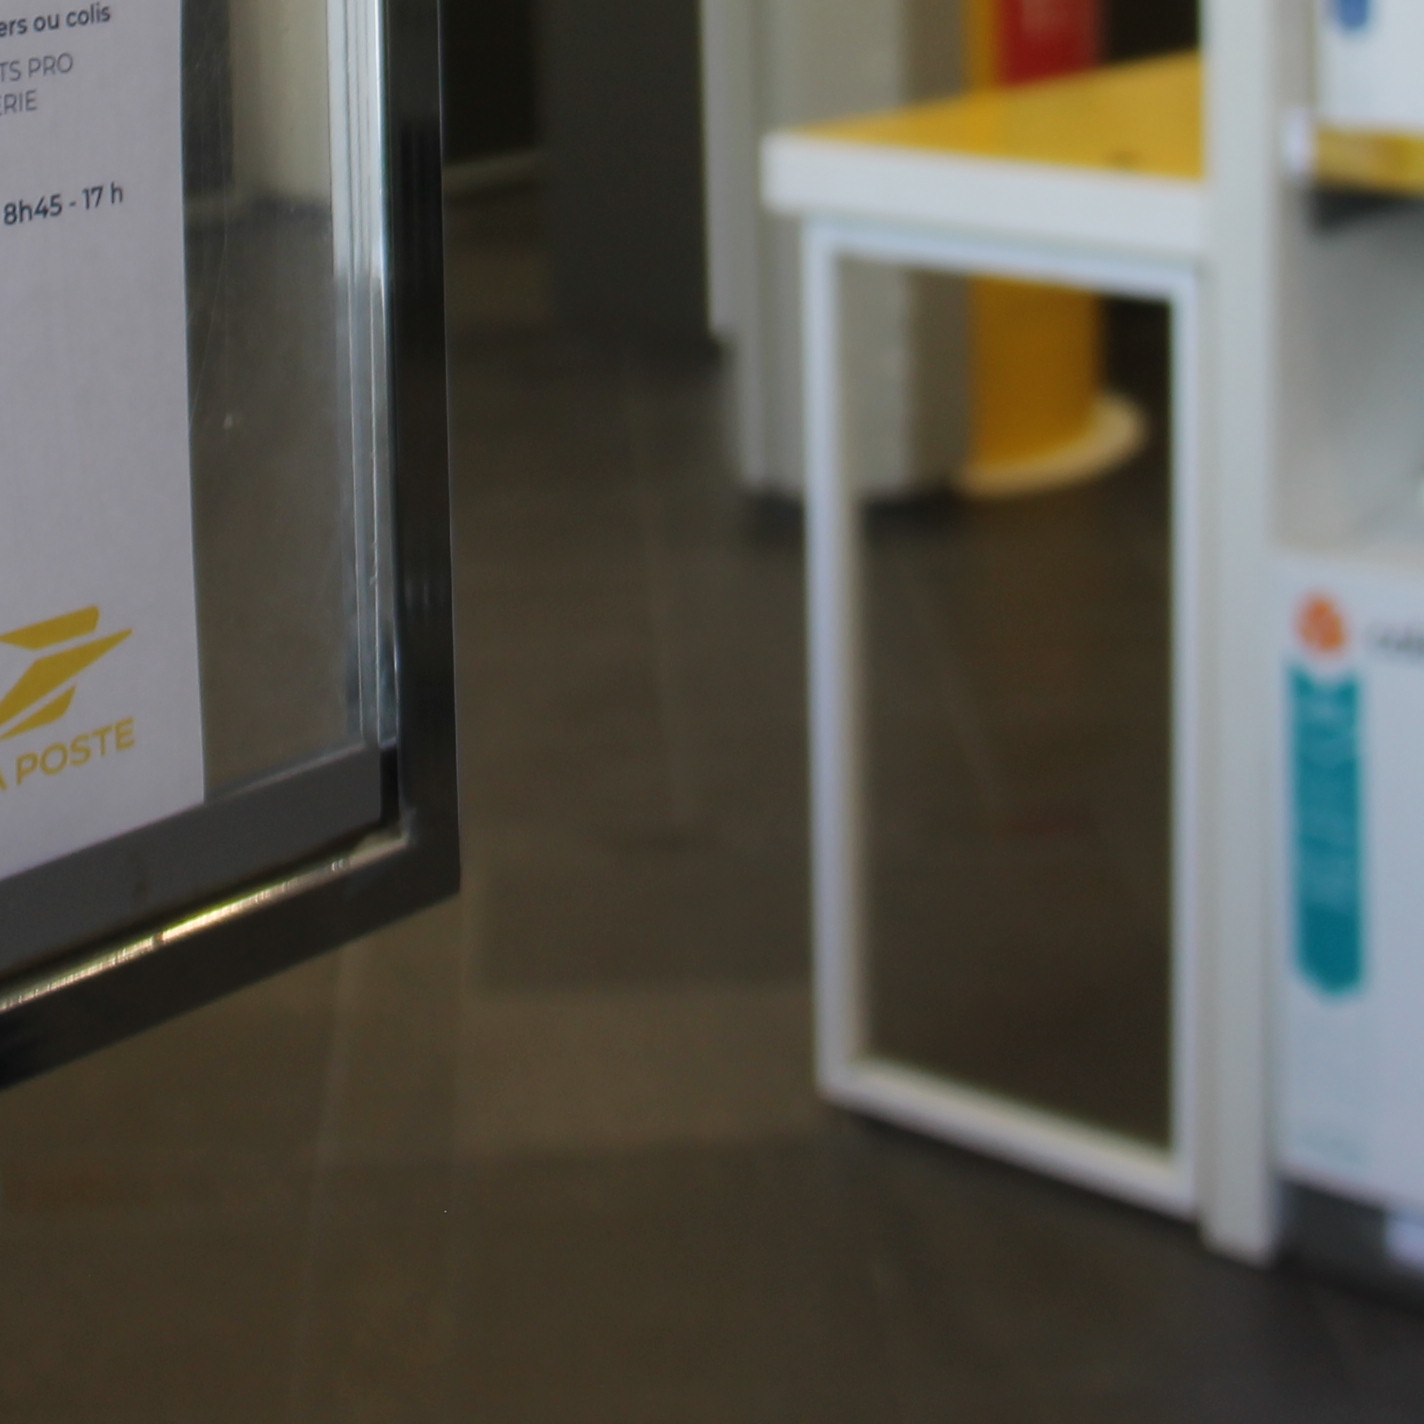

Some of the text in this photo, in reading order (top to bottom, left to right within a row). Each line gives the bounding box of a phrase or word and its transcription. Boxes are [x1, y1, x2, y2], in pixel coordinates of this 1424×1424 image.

[32, 13, 61, 33] ou
[65, 2, 112, 28] colis
[27, 51, 75, 78] PRO
[3, 193, 63, 226] 8h45
[16, 718, 134, 784] POSTE
